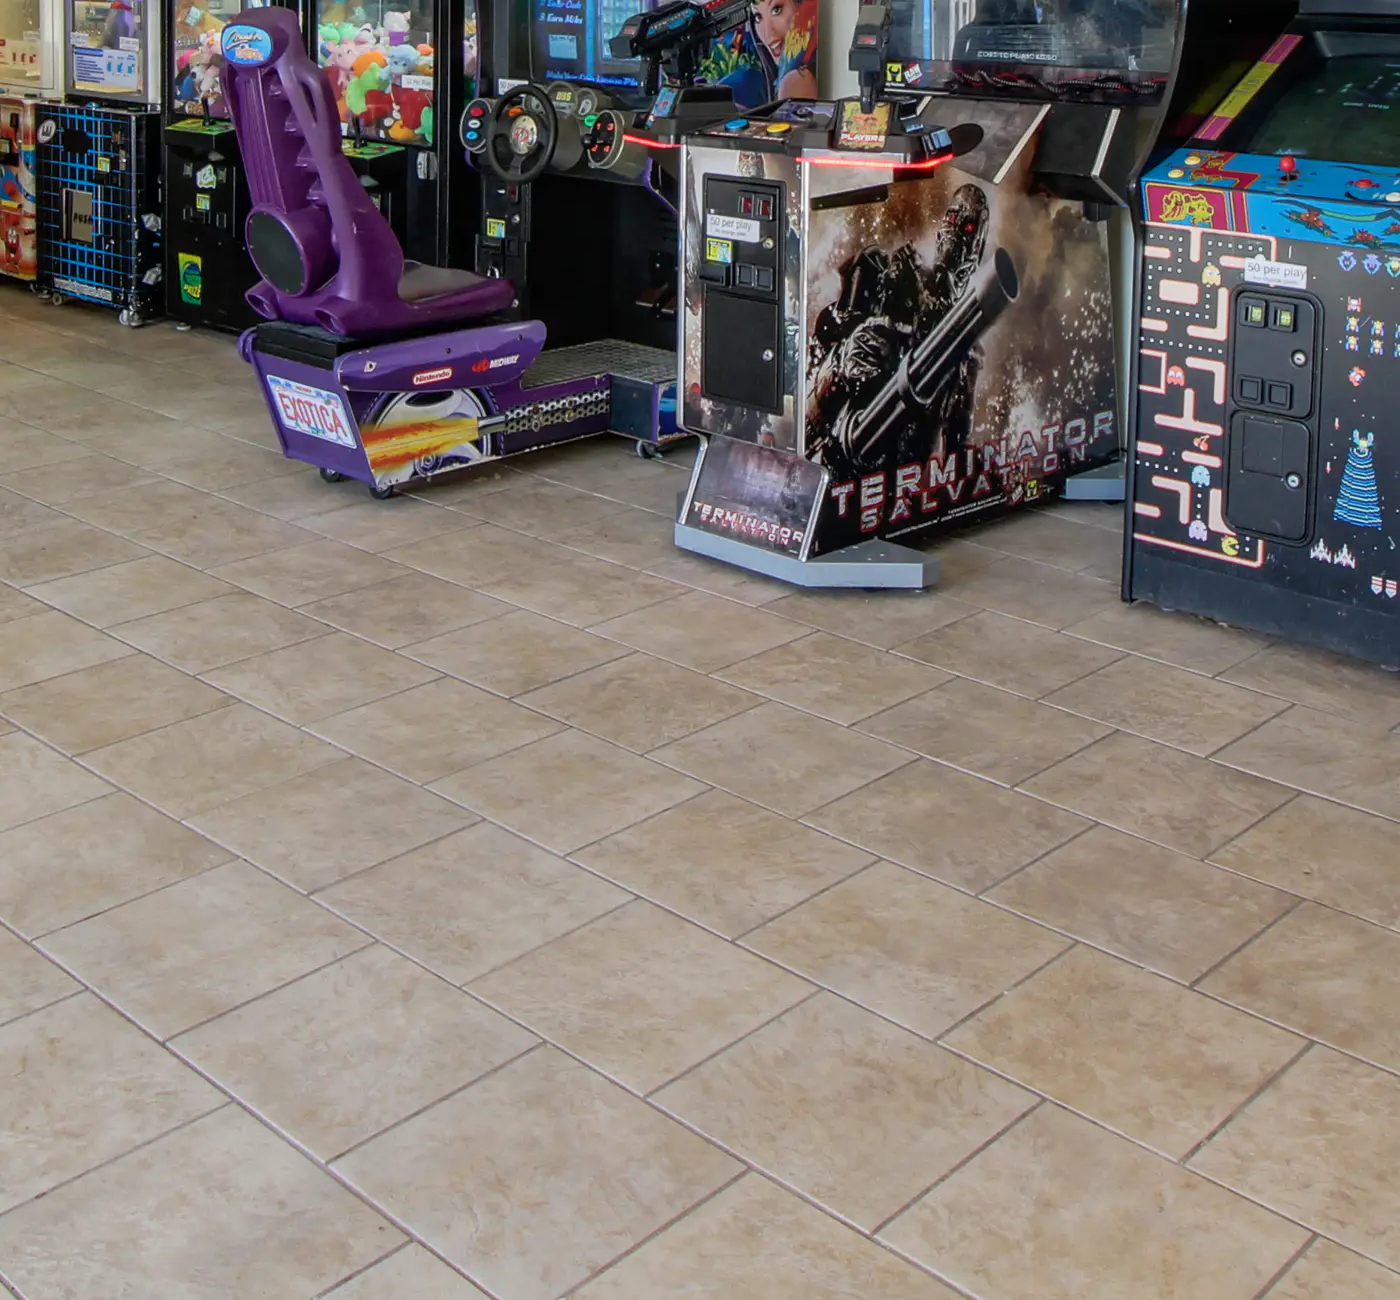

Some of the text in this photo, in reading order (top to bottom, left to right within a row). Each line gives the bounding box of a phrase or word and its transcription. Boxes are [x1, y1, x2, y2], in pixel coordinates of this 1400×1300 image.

[710, 217, 719, 225] 50
[721, 219, 733, 228] per
[1247, 262, 1306, 279] 50 per play
[415, 369, 451, 383] Nintendo
[489, 354, 520, 369] MIDWAY
[279, 393, 347, 437] EXOTICA
[831, 410, 1114, 518] TERMINATOR
[860, 444, 1087, 531] SALVATION
[693, 501, 804, 543] TERMINATOR
[700, 514, 789, 546] SALVATION
